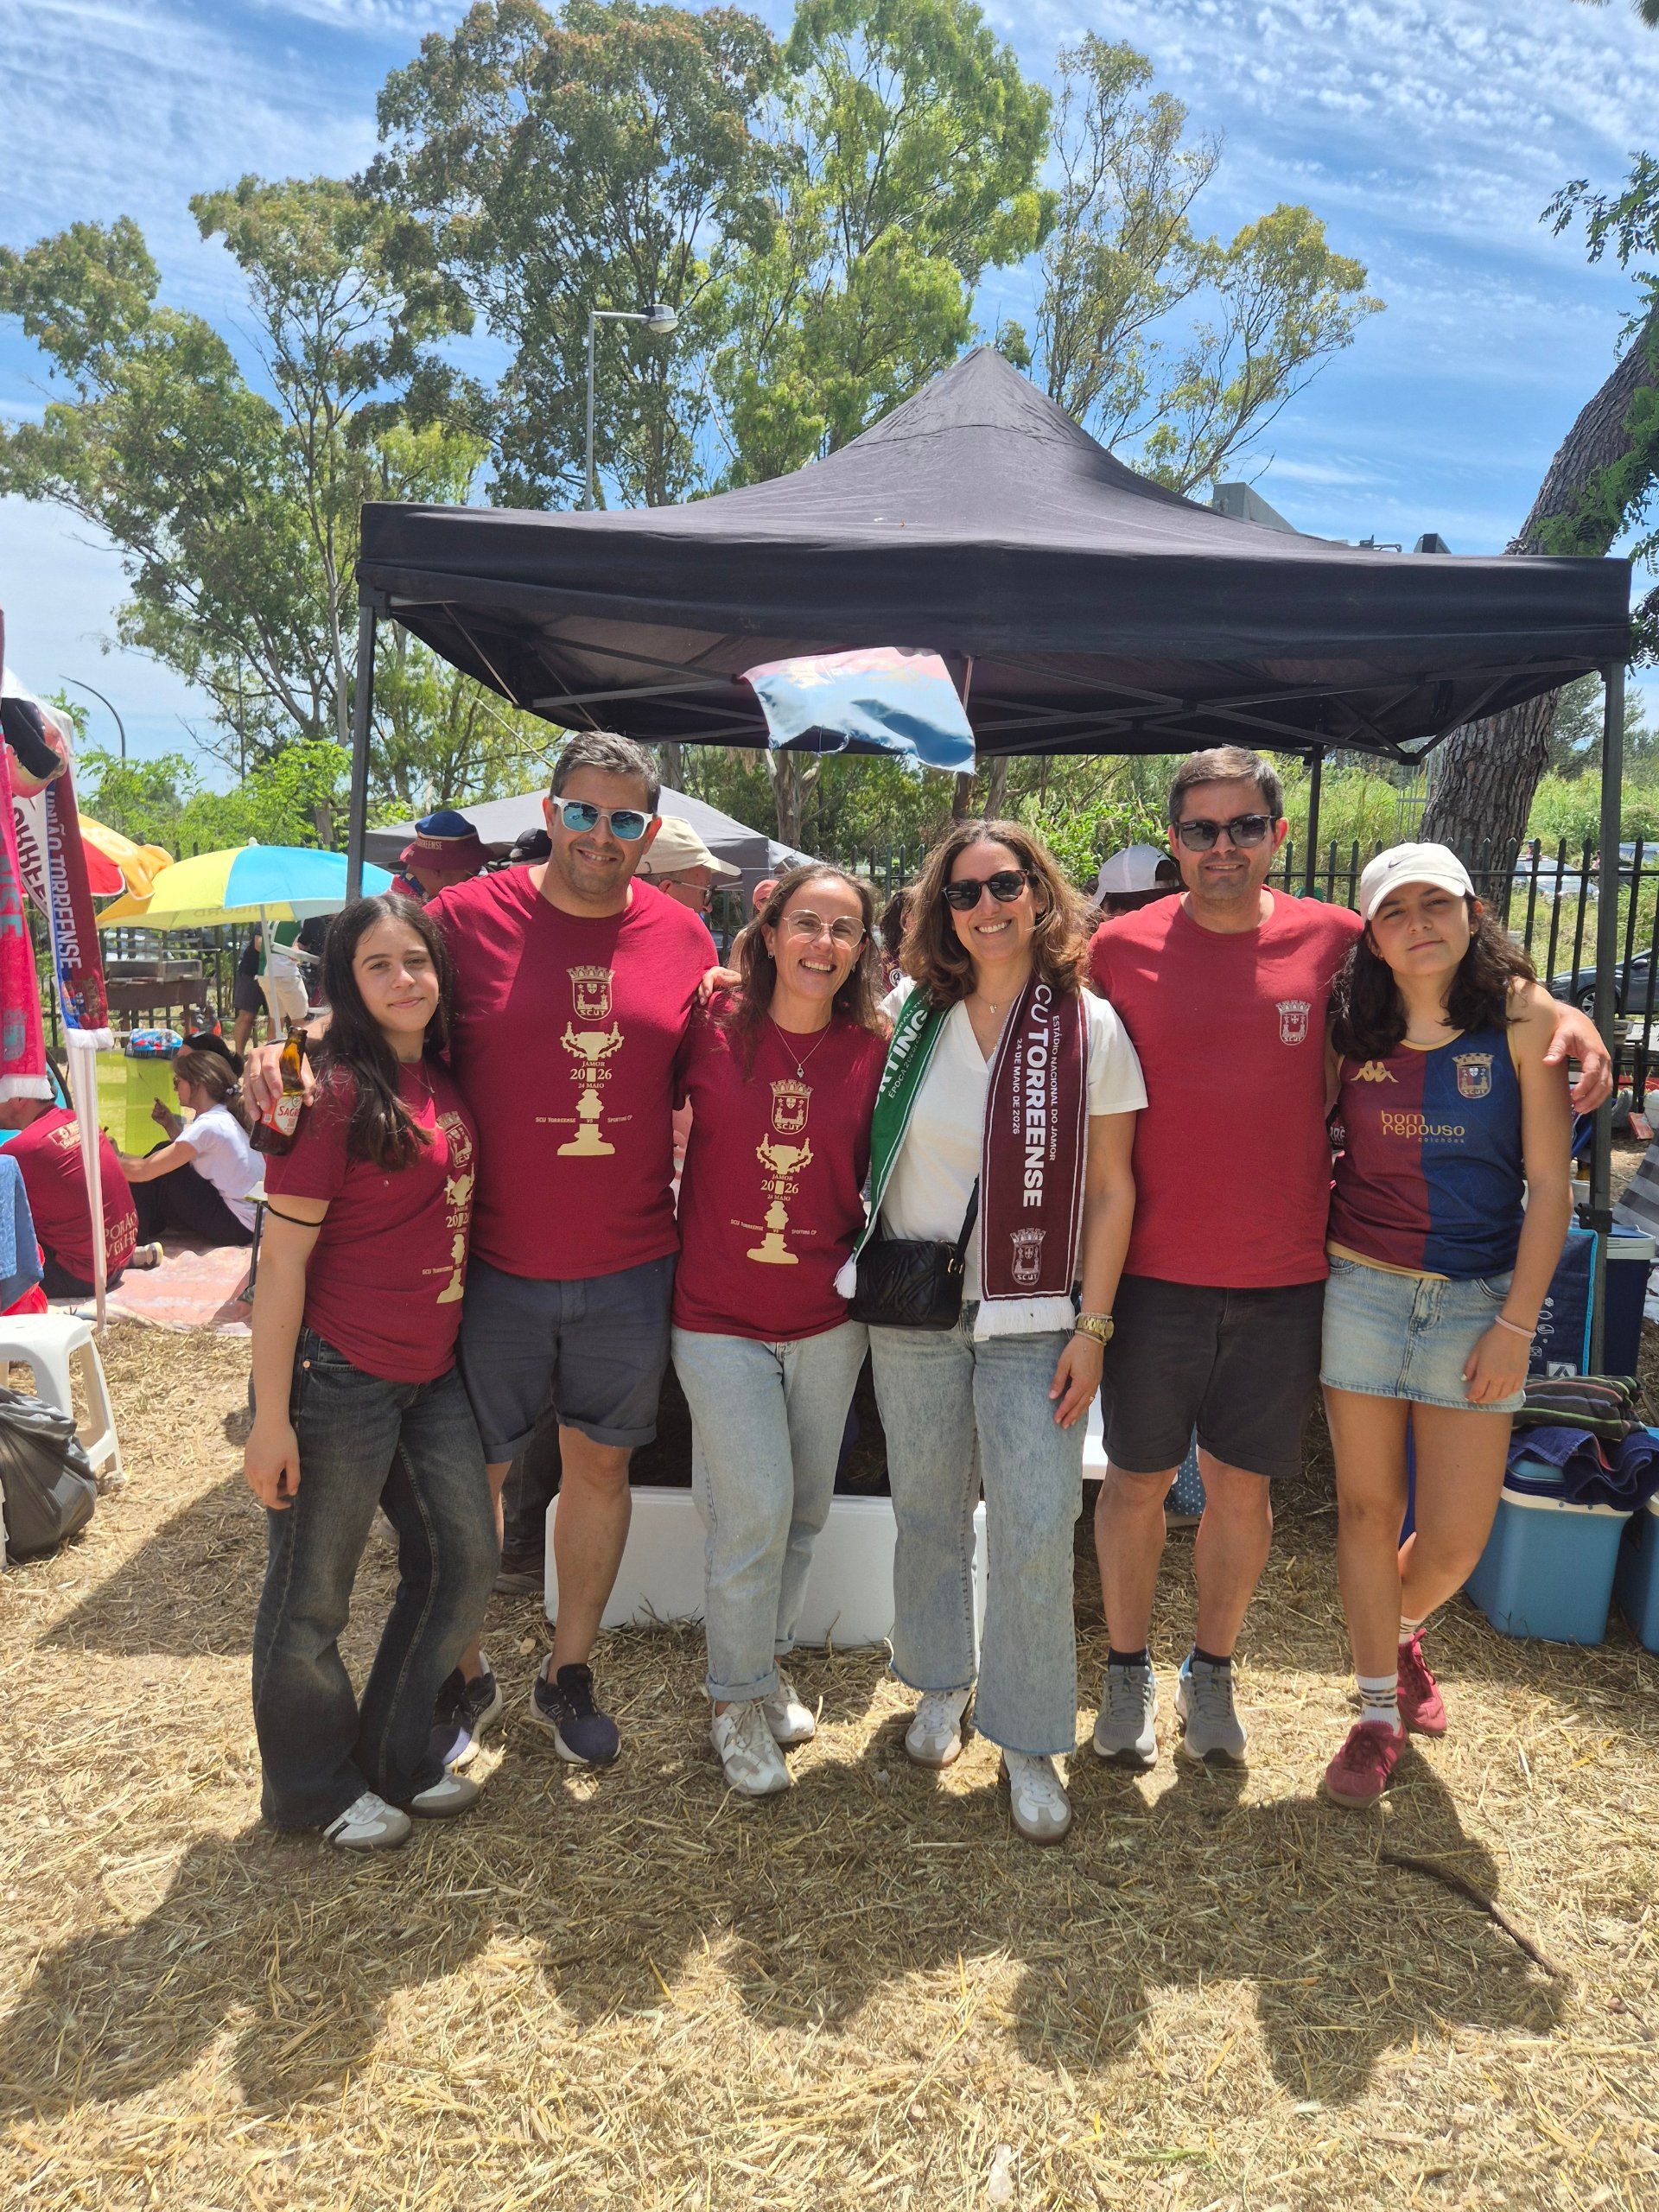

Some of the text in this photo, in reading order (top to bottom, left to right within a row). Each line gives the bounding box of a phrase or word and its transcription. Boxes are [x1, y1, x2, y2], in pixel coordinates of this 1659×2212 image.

[887, 1069, 907, 1099] ÉPOCA
[1012, 1037, 1023, 1135] 24 DE MAIO DE 2026
[1023, 976, 1052, 1207] CU TORREENSE
[1049, 1014, 1063, 1161] ESTÁDIO NACIONAL DO JAMOR
[1381, 1109, 1426, 1125] bom
[1382, 1124, 1465, 1139] repouso
[771, 1173, 794, 1182] JAMOR
